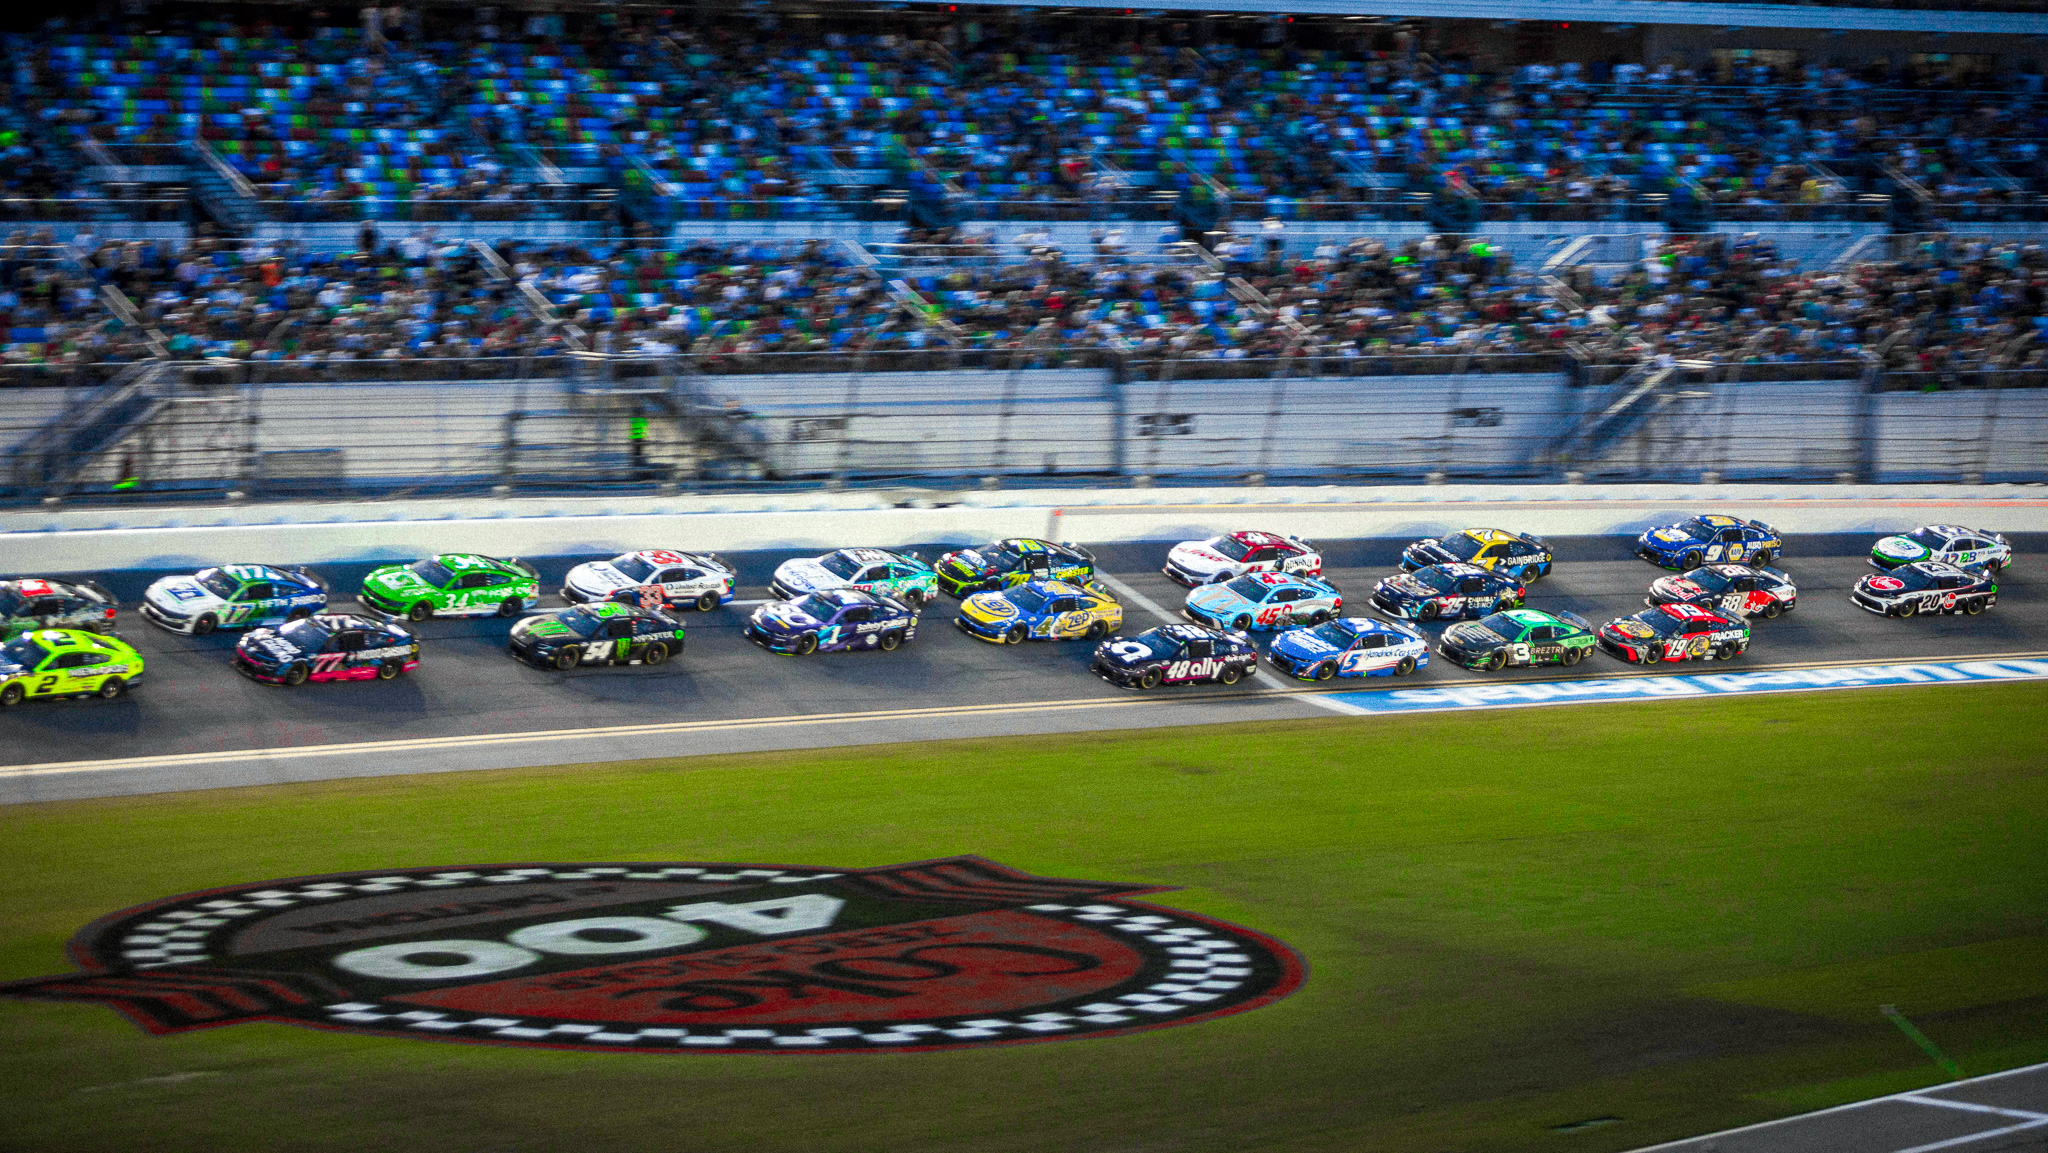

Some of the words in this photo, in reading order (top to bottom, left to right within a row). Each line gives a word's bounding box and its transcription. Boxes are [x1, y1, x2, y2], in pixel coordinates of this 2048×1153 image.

[1507, 553, 1546, 565] GAINBRIDGE
[1704, 544, 1723, 561] 9
[1940, 553, 1959, 563] 42
[1960, 552, 1978, 563] PB
[449, 554, 487, 570] 34
[639, 585, 663, 608] 33
[1042, 580, 1070, 596] 4
[445, 593, 470, 609] 34
[1670, 603, 1704, 617] 19
[1720, 594, 1742, 612] 88
[1921, 593, 1941, 609] 20
[225, 605, 255, 623] 17
[1256, 607, 1281, 625] 45
[828, 624, 842, 645] 1
[1034, 616, 1055, 637] 4
[1710, 629, 1743, 641] TRACKER
[582, 641, 615, 660] 54
[1513, 642, 1531, 660] 3
[1530, 646, 1565, 655] BREZTRI
[1668, 639, 1688, 657] 19
[311, 652, 347, 674] 77
[1167, 660, 1191, 679] 48
[1190, 658, 1225, 679] ally
[1342, 653, 1363, 671] 5
[34, 675, 59, 693] 2
[333, 894, 846, 979] 400
[528, 950, 777, 992] SUGAR
[611, 942, 1102, 1013] Coke
